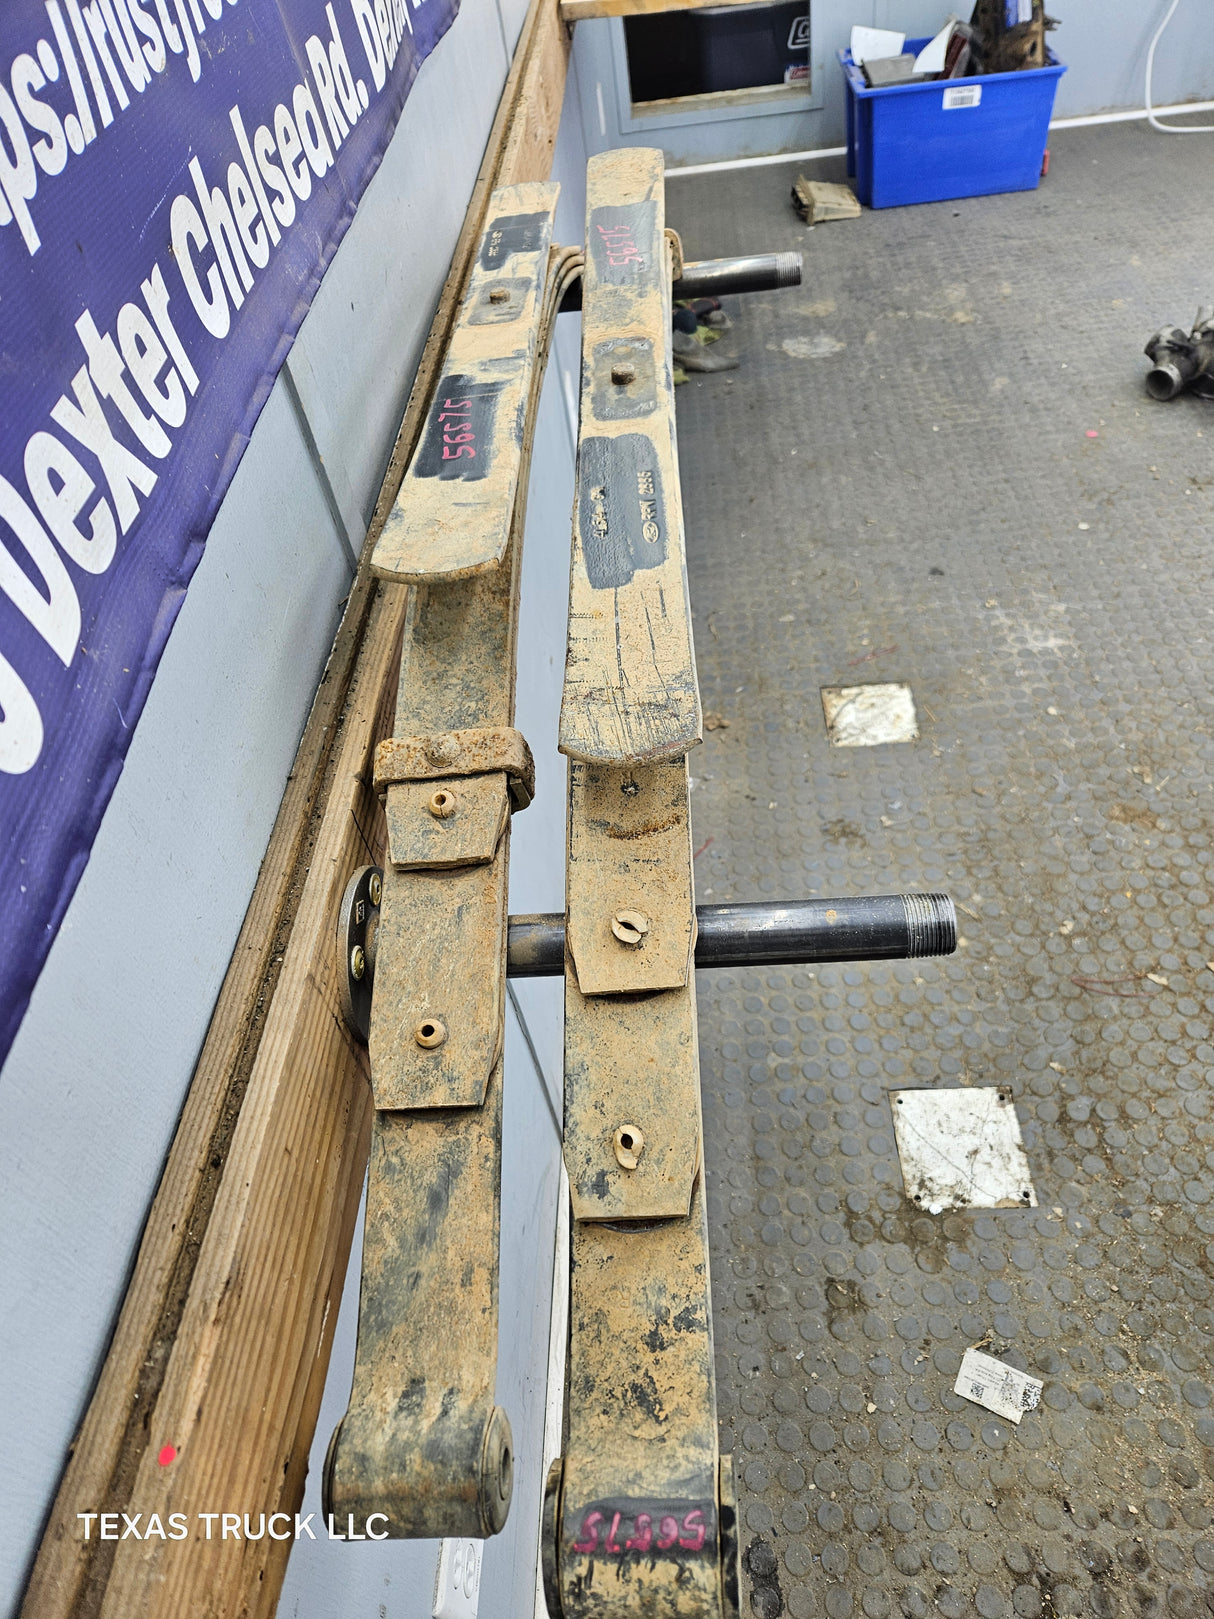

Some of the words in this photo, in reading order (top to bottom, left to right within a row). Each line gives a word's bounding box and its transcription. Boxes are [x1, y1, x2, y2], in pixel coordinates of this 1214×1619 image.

[0, 263, 200, 668] Dexter
[169, 104, 334, 339] Chelsea
[304, 1, 369, 151] Rd.
